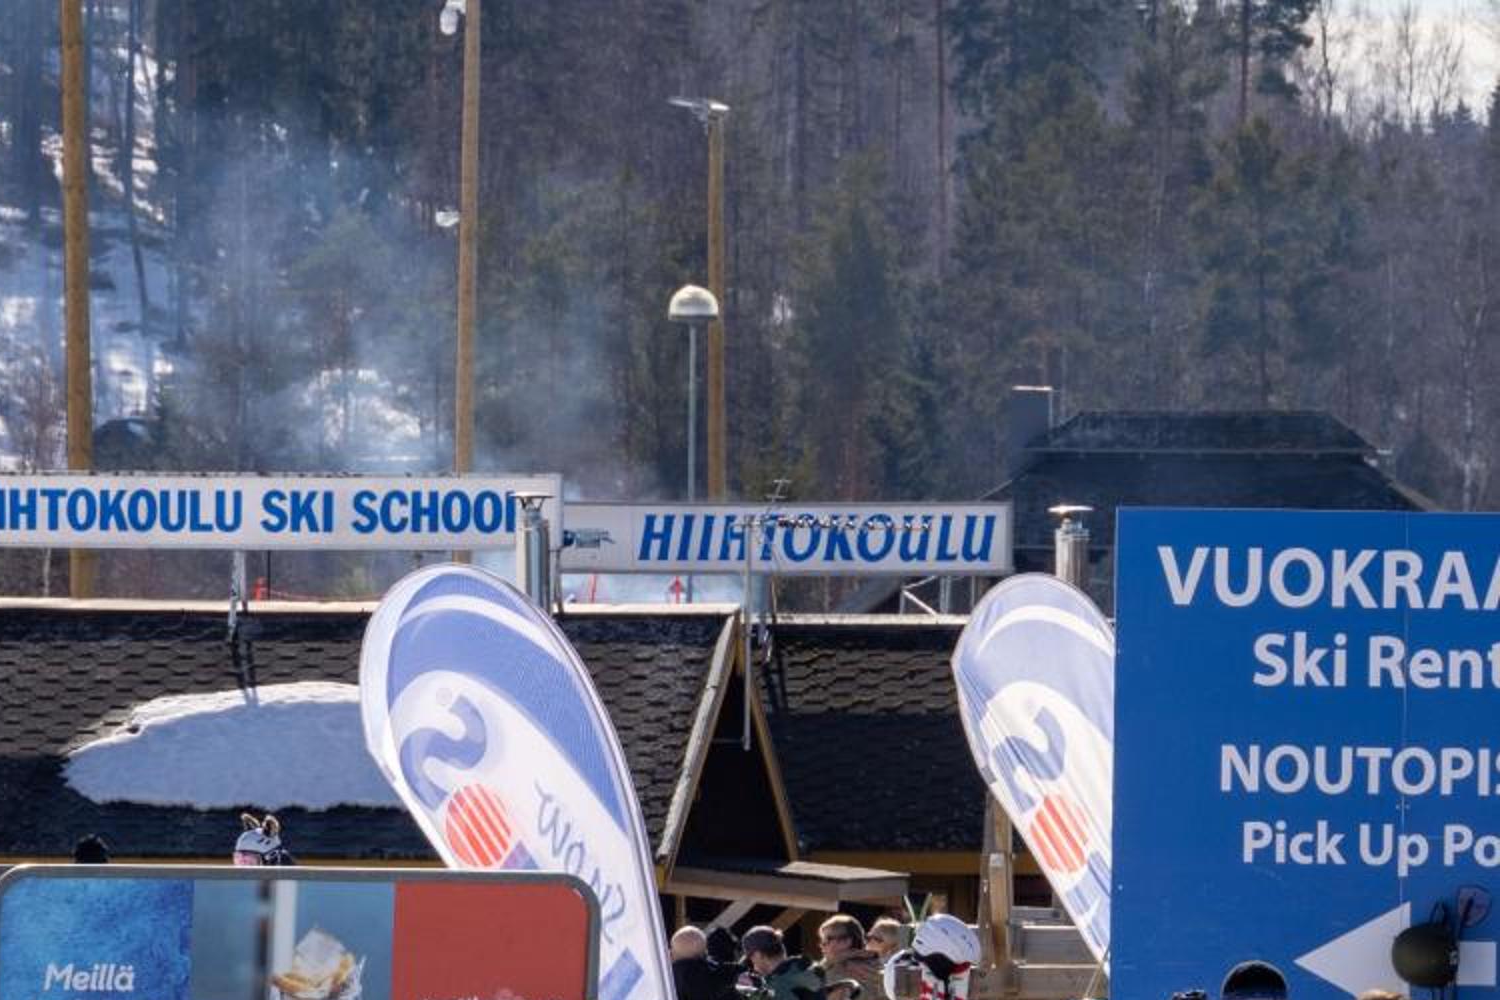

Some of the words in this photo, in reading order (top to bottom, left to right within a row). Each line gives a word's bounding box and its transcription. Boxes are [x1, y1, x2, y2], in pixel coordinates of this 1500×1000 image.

[260, 490, 334, 534] SKI
[1253, 632, 1347, 688] Ski
[1219, 744, 1500, 798] NOUTOPI
[1243, 821, 1347, 866] Pick
[1359, 824, 1429, 877] Up
[43, 962, 135, 992] Meillä
